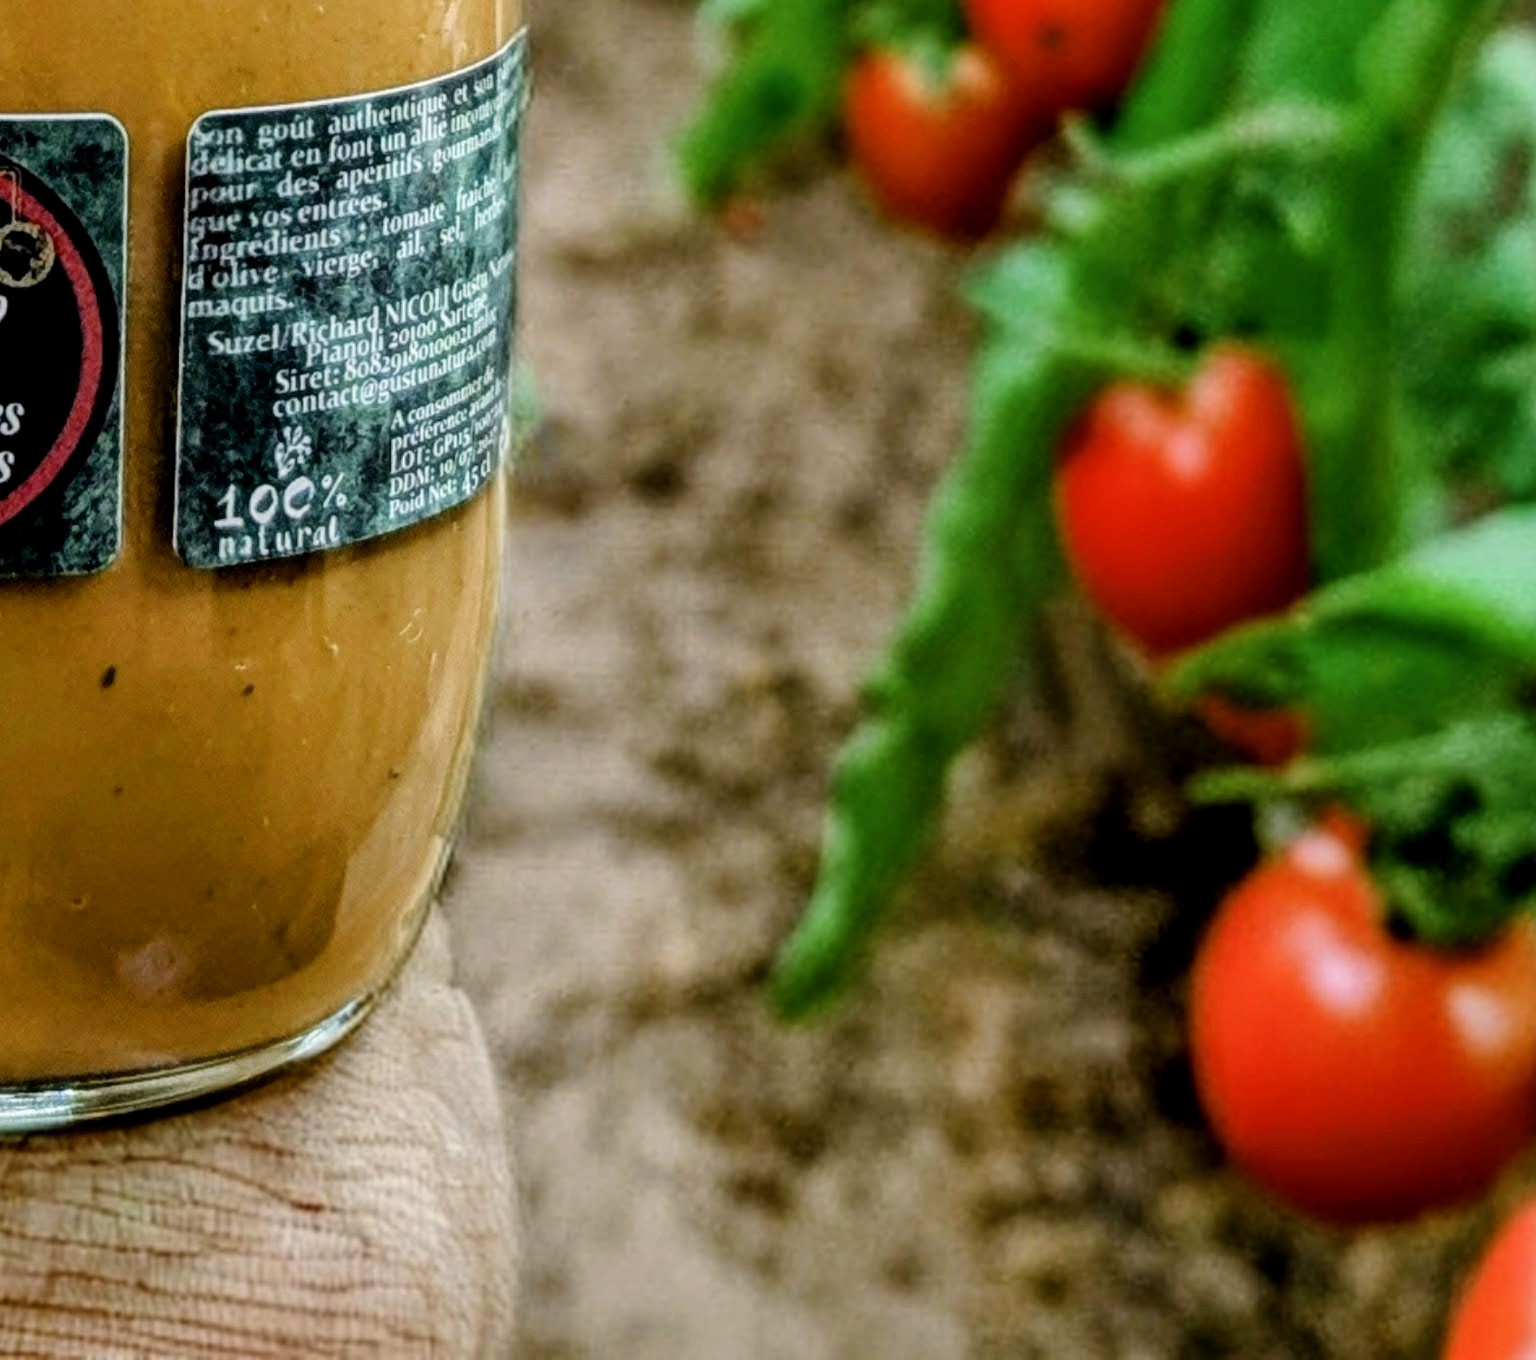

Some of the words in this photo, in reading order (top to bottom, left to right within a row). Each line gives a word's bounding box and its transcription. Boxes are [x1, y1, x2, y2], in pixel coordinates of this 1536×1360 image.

[257, 113, 315, 149] goût
[327, 93, 447, 134] authentique
[454, 83, 468, 105] et
[290, 147, 322, 168] en
[328, 135, 374, 164] font
[381, 130, 406, 154] un
[410, 112, 448, 146] allié
[190, 182, 258, 211] pour
[277, 170, 320, 198] des
[335, 149, 424, 195] apéritifs
[189, 228, 341, 268] Ingrédients
[382, 202, 446, 236] tomate
[190, 213, 242, 241] que
[249, 206, 293, 228] vos
[301, 250, 379, 279] vierge,
[396, 229, 425, 259] ail,
[187, 288, 295, 321] maquis.
[386, 284, 449, 327] NICOLI
[305, 328, 384, 367] Pianoli
[388, 318, 437, 349] 20100
[272, 328, 497, 418] contact@gustunatura.com
[274, 366, 340, 395] Siret:
[390, 409, 405, 431] A
[407, 376, 482, 424] consommer
[389, 465, 435, 498] DDM:
[390, 443, 431, 475] LOT:
[389, 487, 425, 519] Poid
[428, 478, 457, 505] Net:
[218, 515, 340, 559] natural
